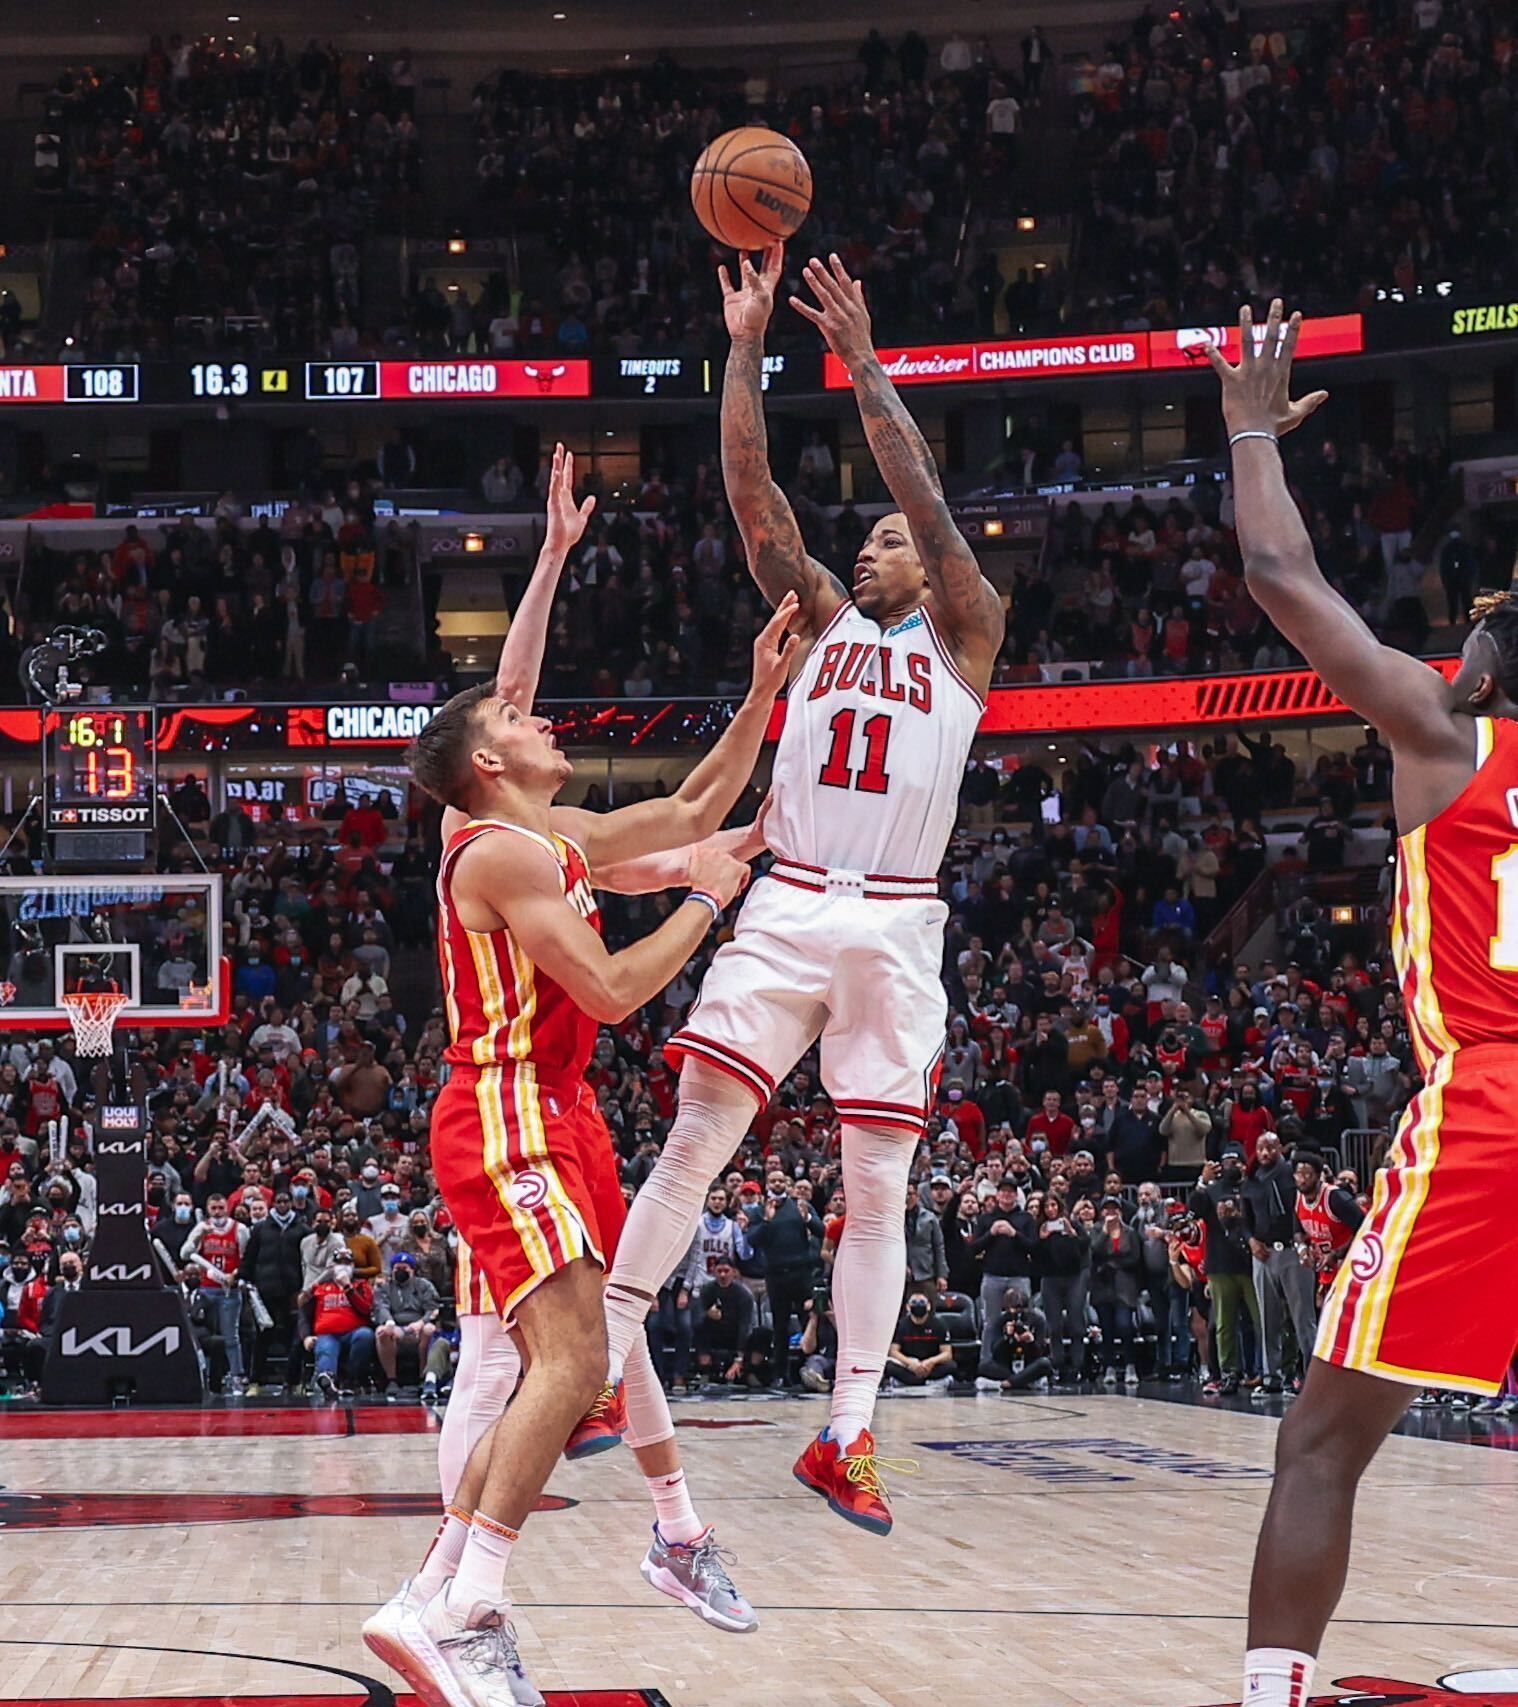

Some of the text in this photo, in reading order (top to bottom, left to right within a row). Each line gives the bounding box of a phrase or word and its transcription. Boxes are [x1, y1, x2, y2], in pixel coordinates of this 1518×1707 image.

[1452, 303, 1518, 334] STEALS
[620, 360, 681, 375] TIMEOUTS
[879, 343, 1135, 377] dweiser CHAMPIONS CLUB
[82, 369, 123, 397] 108
[191, 363, 248, 396] 16.3
[324, 367, 365, 394] 107
[408, 364, 497, 393] CHICAGO
[644, 376, 656, 393] 2
[806, 640, 933, 715] BULLS
[69, 717, 122, 747] 16.1
[327, 706, 429, 738] CHICAGO
[818, 707, 893, 794] 11
[87, 747, 132, 797] 13
[78, 807, 149, 822] TISSOT
[105, 1118, 138, 1128] MOLY
[703, 1239, 729, 1257] ULLS
